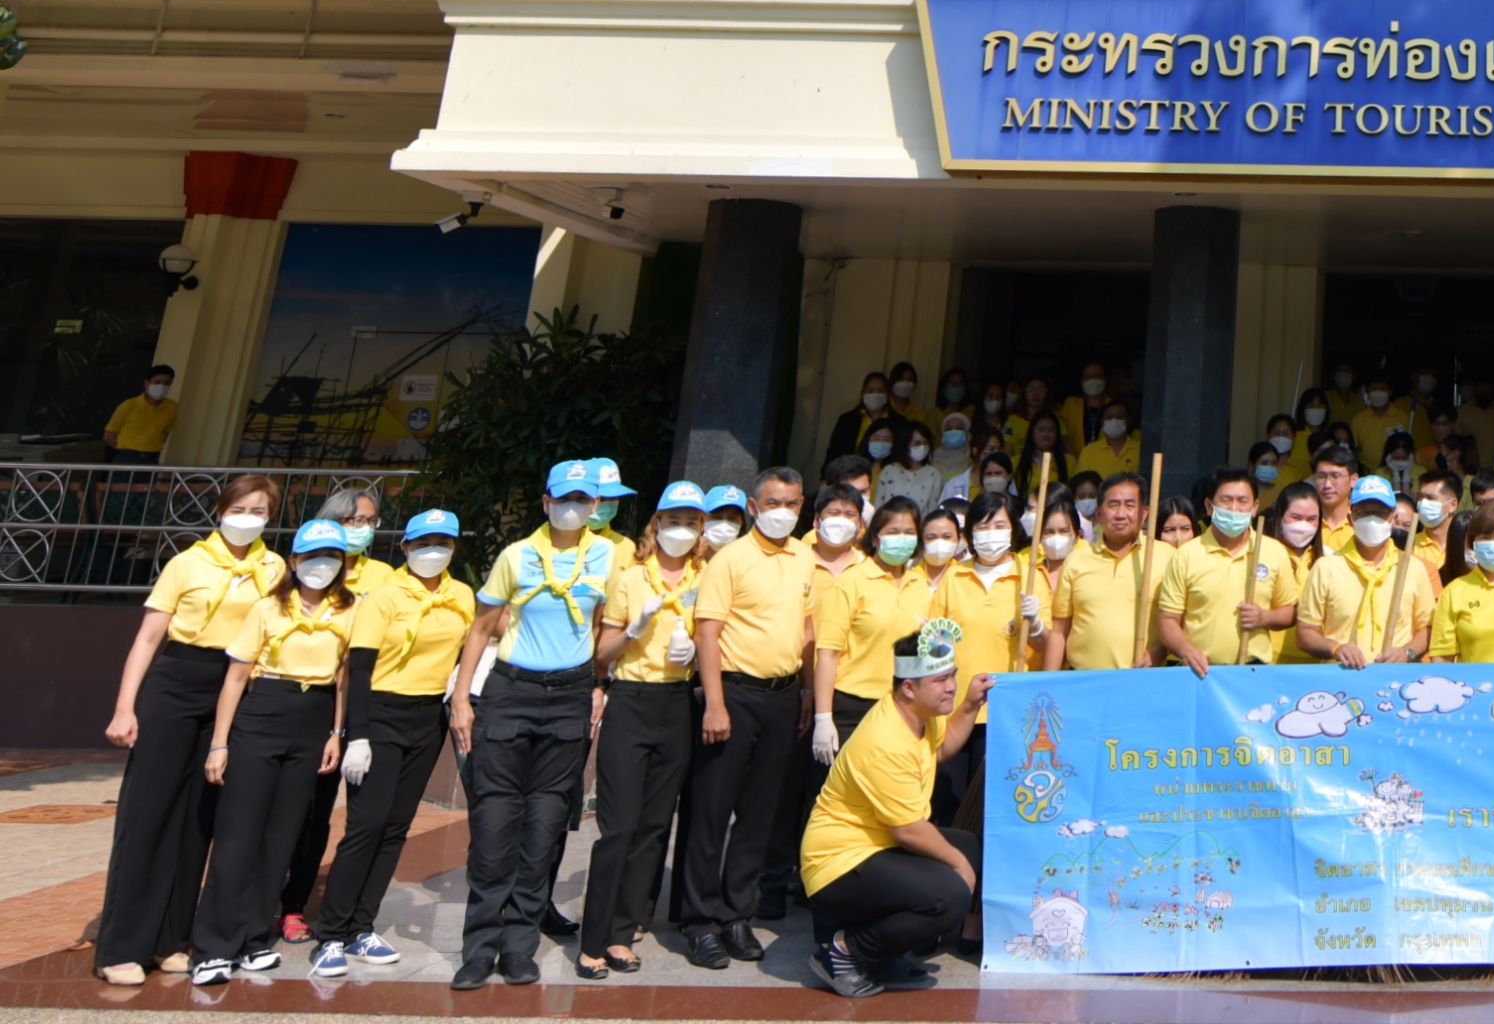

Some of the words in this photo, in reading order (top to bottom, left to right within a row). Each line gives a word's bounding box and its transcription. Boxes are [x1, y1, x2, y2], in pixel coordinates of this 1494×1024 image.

[1001, 97, 1230, 133] MINISTRY
[1245, 101, 1306, 133] OF
[1104, 736, 1351, 771] โครงการจิตอาสา
[1313, 858, 1388, 878] จิตอาสา
[1314, 892, 1372, 914] อำเภอ
[1393, 894, 1494, 919] เขตปทุมวน
[1313, 927, 1377, 950] จังหวัด
[1399, 931, 1482, 955] กรุงเทพฯ
